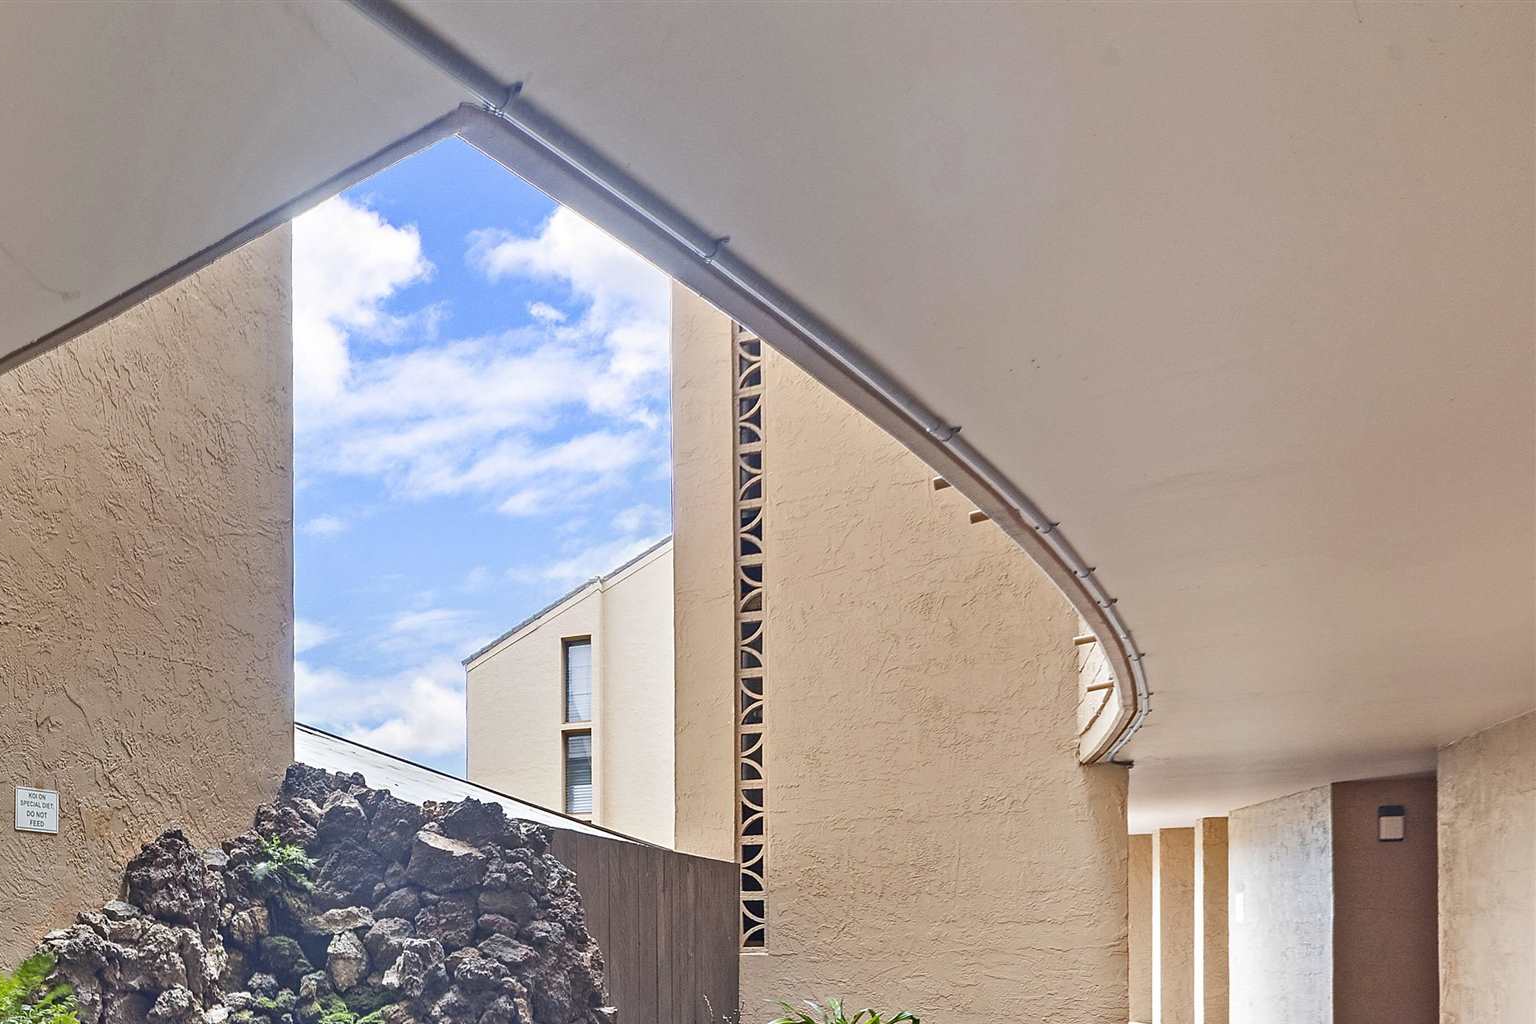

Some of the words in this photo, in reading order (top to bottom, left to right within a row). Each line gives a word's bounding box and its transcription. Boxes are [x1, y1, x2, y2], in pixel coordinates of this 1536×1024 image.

[20, 799, 41, 809] SPECIAL
[36, 811, 47, 819] NOT
[29, 819, 45, 828] FEED
